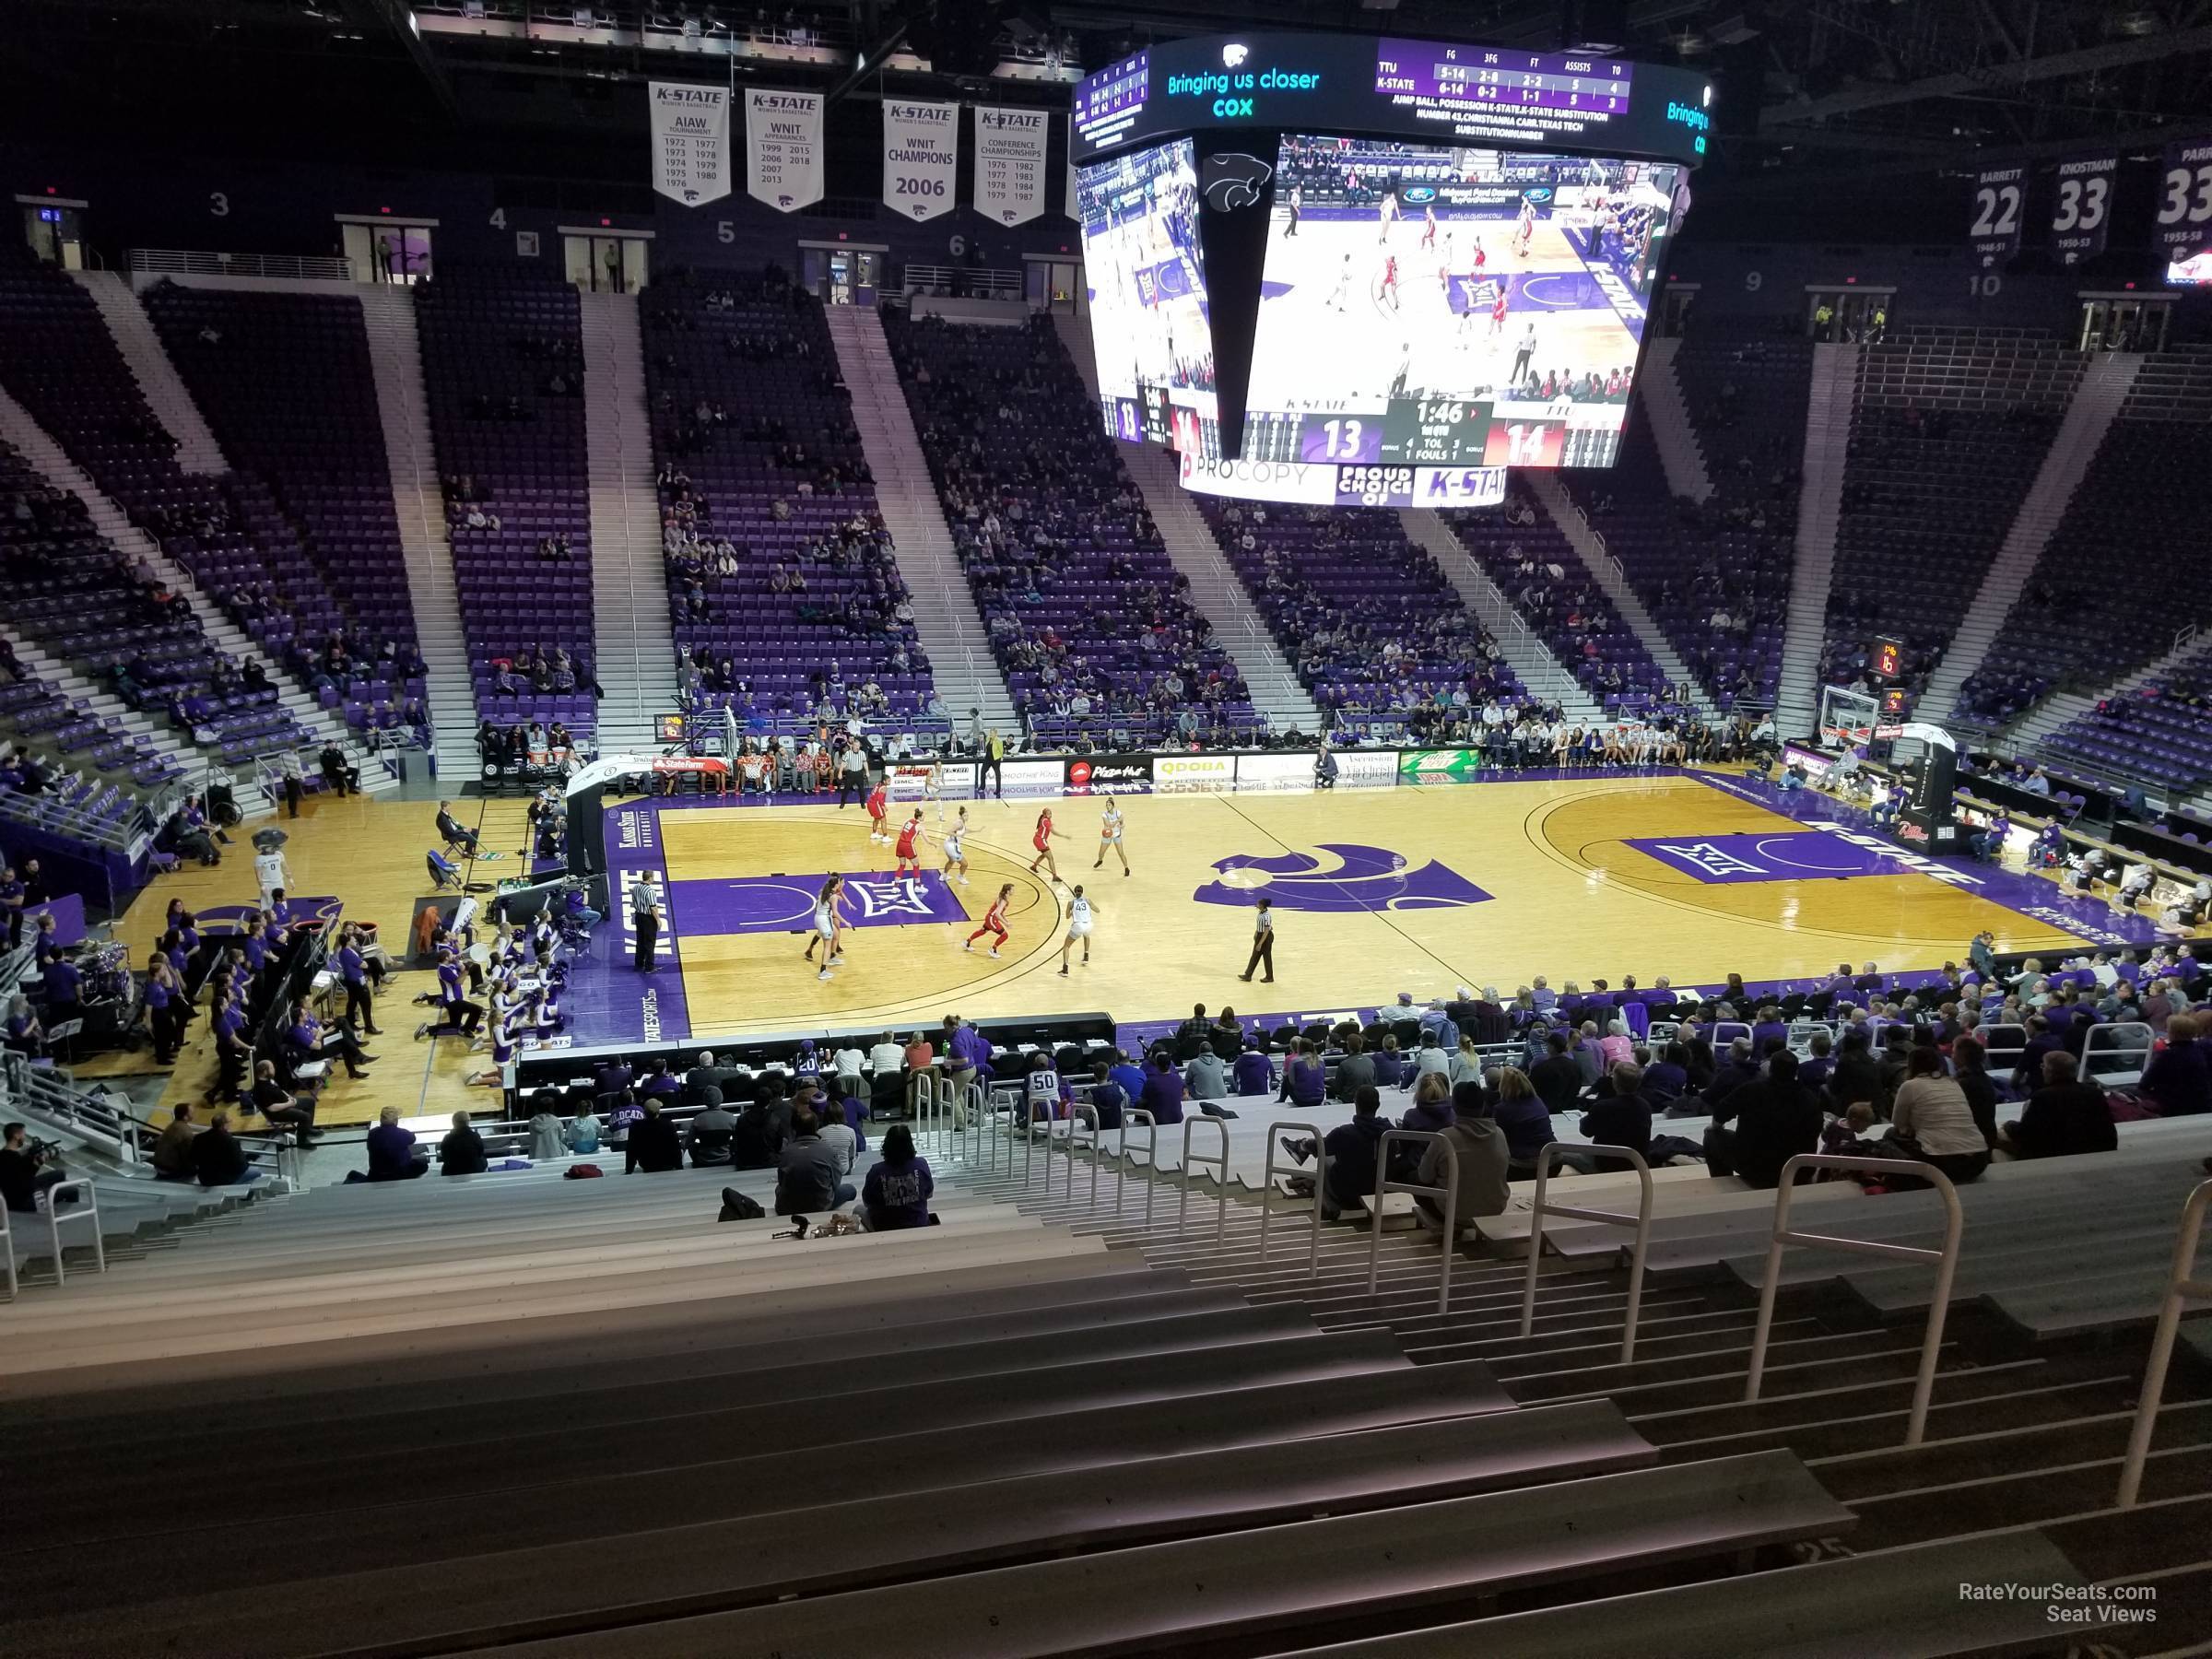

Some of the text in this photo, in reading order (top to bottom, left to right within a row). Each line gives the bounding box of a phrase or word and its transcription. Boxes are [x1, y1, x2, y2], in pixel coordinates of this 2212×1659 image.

[1446, 50, 1621, 76] FG 3FG FT ASSISTS TO
[1168, 68, 1319, 95] Bringing us closer
[1379, 61, 1397, 74] TTU
[1441, 66, 1465, 79] 5-14
[1524, 75, 1542, 87] 2-2
[1571, 79, 1579, 90] 5
[1610, 82, 1618, 93] 4
[657, 88, 723, 104] K-STATE
[1377, 76, 1415, 91] K-STATE
[1477, 86, 1497, 99] 0-2
[1523, 89, 1540, 102] 1-1
[1571, 94, 1578, 106] 5
[1608, 97, 1616, 109] 3
[686, 101, 717, 110] BASKETBALL
[753, 95, 817, 111] K-STATE
[1392, 94, 1416, 105] JUMP
[1439, 98, 1488, 112] POSSESSION
[1553, 107, 1608, 122] SUBSTITUTION
[890, 105, 951, 122] K-STATE
[982, 112, 1041, 128] K-STATE
[1667, 101, 1703, 129] Bringing
[675, 116, 707, 128] AIAW
[1417, 109, 1452, 121] NUMBER
[1562, 121, 1583, 133] TECH
[669, 126, 711, 135] TOURNAMENT
[771, 122, 801, 135] WNIT
[665, 138, 715, 148] 1972 1977
[761, 144, 809, 155] 1999 2015
[906, 138, 935, 149] WNIT
[988, 139, 1035, 149] CONFERENCE
[665, 148, 716, 159] 1973 1978
[760, 154, 809, 165] 2006 2018
[888, 149, 953, 165] CHAMPIONS
[981, 147, 1041, 158] CHAMPIONSHIPS
[665, 159, 716, 169] 1974 1979
[761, 164, 782, 173] 2007
[987, 160, 1033, 171] 1976 1982
[2059, 159, 2116, 175] KNOSTMAN
[665, 169, 716, 180] 1975 1980
[761, 175, 782, 184] 2013
[988, 171, 1033, 181] 1977 1983
[1980, 169, 2022, 183] BARRETT
[666, 179, 687, 188] 1976
[896, 177, 945, 196] 2006
[987, 181, 1033, 191] 1978 1984
[987, 191, 1033, 201] 1979 1987
[2158, 165, 2212, 224] 33
[209, 192, 229, 217] 3
[1971, 185, 2020, 236] 22
[2053, 177, 2108, 231] 33
[488, 207, 507, 229] 4
[717, 220, 735, 243] 5
[2163, 230, 2204, 243] 1955-58
[948, 234, 965, 257] 6
[1745, 271, 1762, 292] 9
[1970, 276, 2001, 296] 10
[1417, 401, 1464, 424] 1:46
[1324, 419, 1362, 459] 13
[1406, 438, 1461, 450] 4 TOL 3
[1506, 425, 1546, 463] 14
[1406, 450, 1458, 461] 1 FOULS 1
[1197, 457, 1309, 486] PROCOPY
[1342, 466, 1412, 481] PROUD
[1338, 479, 1412, 494] CHOICE
[1362, 492, 1389, 506] OF
[1349, 754, 1393, 763] Ascension
[1091, 765, 1146, 779] Pizza Hut
[1160, 761, 1226, 775] QDOBA
[1803, 819, 1986, 885] K-STATE
[1075, 901, 1087, 912] 43
[799, 1060, 816, 1072] 20
[1033, 1076, 1054, 1090] 50
